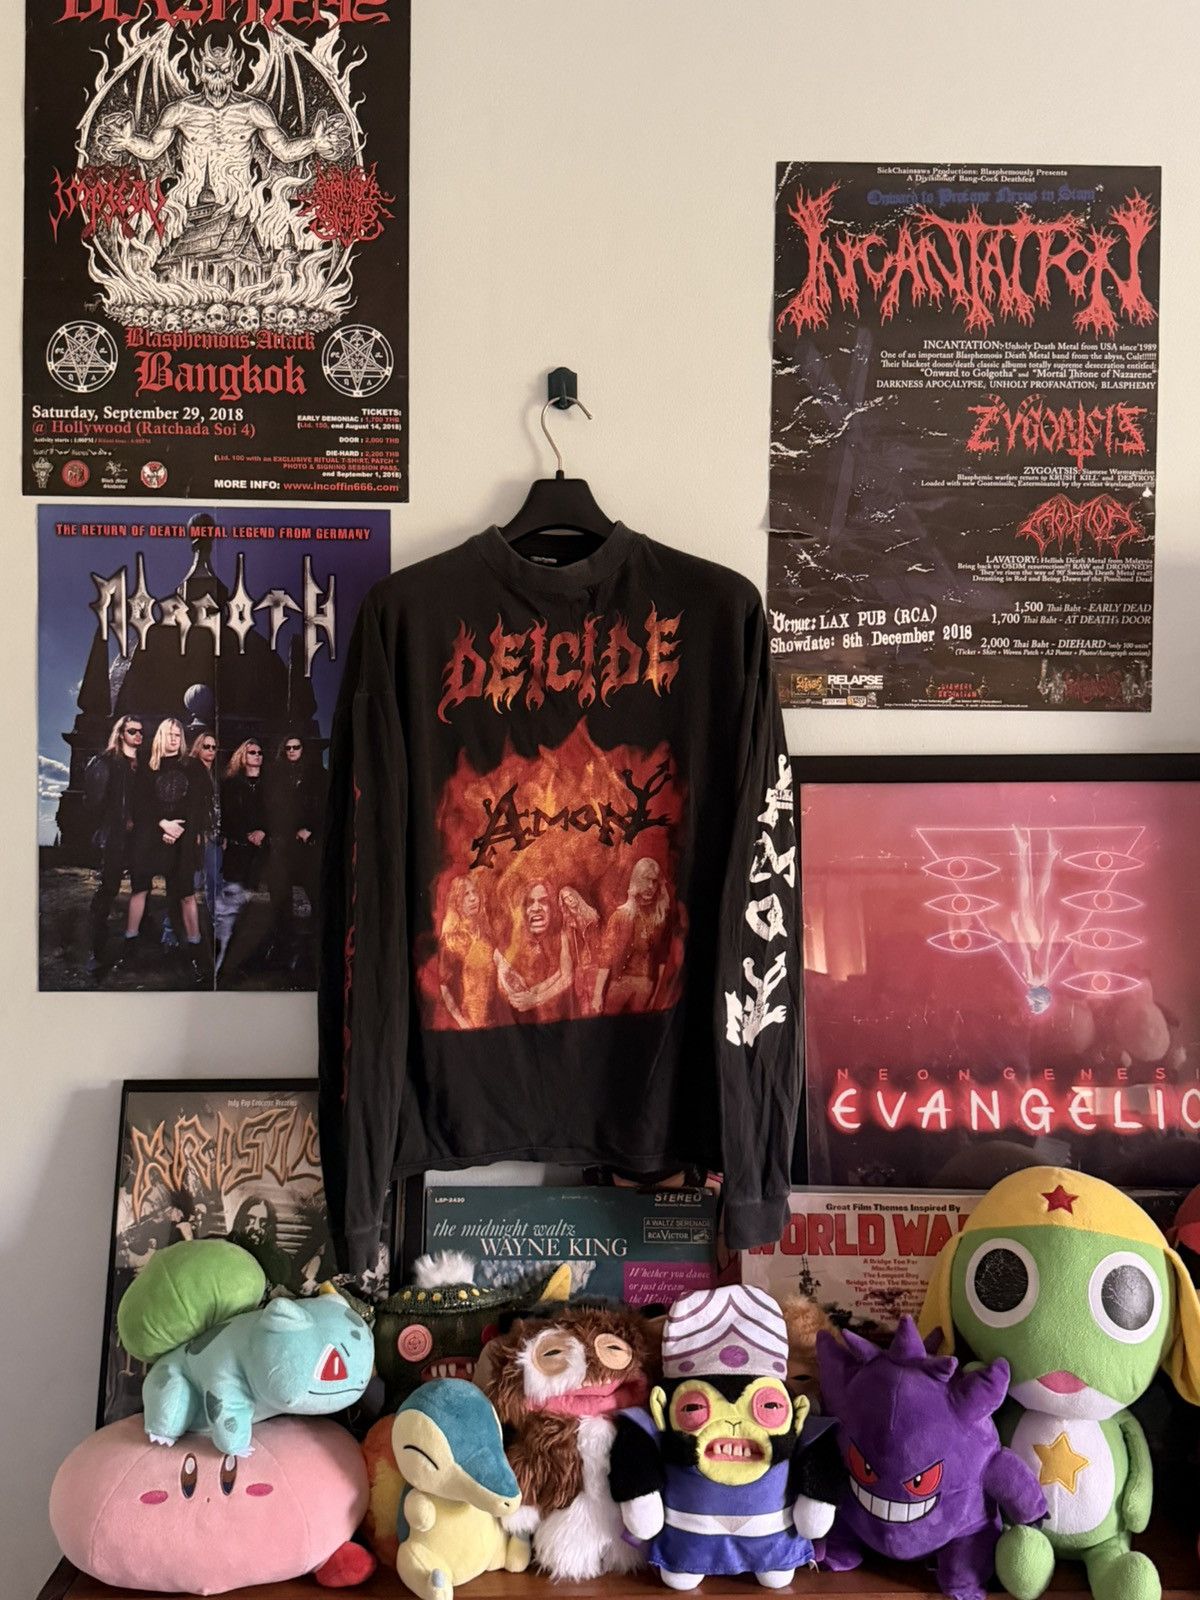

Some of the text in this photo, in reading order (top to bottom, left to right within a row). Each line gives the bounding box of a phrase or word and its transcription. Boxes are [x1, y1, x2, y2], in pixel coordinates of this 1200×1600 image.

[980, 168, 1035, 177] Blasphemously
[777, 180, 1158, 339] INCANTATION
[126, 327, 316, 350] Blasphemous Attack
[918, 351, 954, 360] important
[1029, 361, 1051, 370] totally
[134, 351, 307, 400] Bangkok
[1068, 369, 1099, 379] Throne
[1101, 370, 1111, 378] of
[876, 380, 924, 388] DARKNESS
[1101, 381, 1156, 390] BLASPHEMY
[32, 405, 243, 422] Saturday, September 29, 2018
[32, 420, 256, 438] @ Hollywood (Ratchada Soi 4)
[214, 480, 399, 491] MORE INFO: www.incoffin666.com
[57, 524, 370, 539] THE RETURN OF DEATH METAL LEGEND FROM GERMANY
[1015, 602, 1043, 613] 1,500
[1089, 604, 1121, 612] EARLY
[1123, 604, 1152, 612] DEAD
[820, 614, 849, 630] LAX
[858, 610, 886, 626] PUB
[894, 604, 937, 625] (RCA)
[992, 613, 1020, 625] 1,700
[1065, 616, 1078, 624] AT
[1121, 616, 1152, 624] DOOR
[770, 624, 972, 654] Showdate: 8th December 2018
[981, 638, 1106, 649] 2,000 Thai Baht DIEHARD
[438, 600, 685, 724] DEICIDE
[827, 675, 883, 685] RELAPSE
[837, 1068, 972, 1081] NEON
[654, 1193, 702, 1202] STEREO
[910, 1204, 947, 1213] Inspired
[949, 1204, 960, 1213] By
[433, 1219, 576, 1239] the midnight waltz
[480, 1238, 628, 1256] WAYNE KING
[670, 1270, 684, 1280] you
[638, 1282, 656, 1292] just
[658, 1282, 684, 1291] dream
